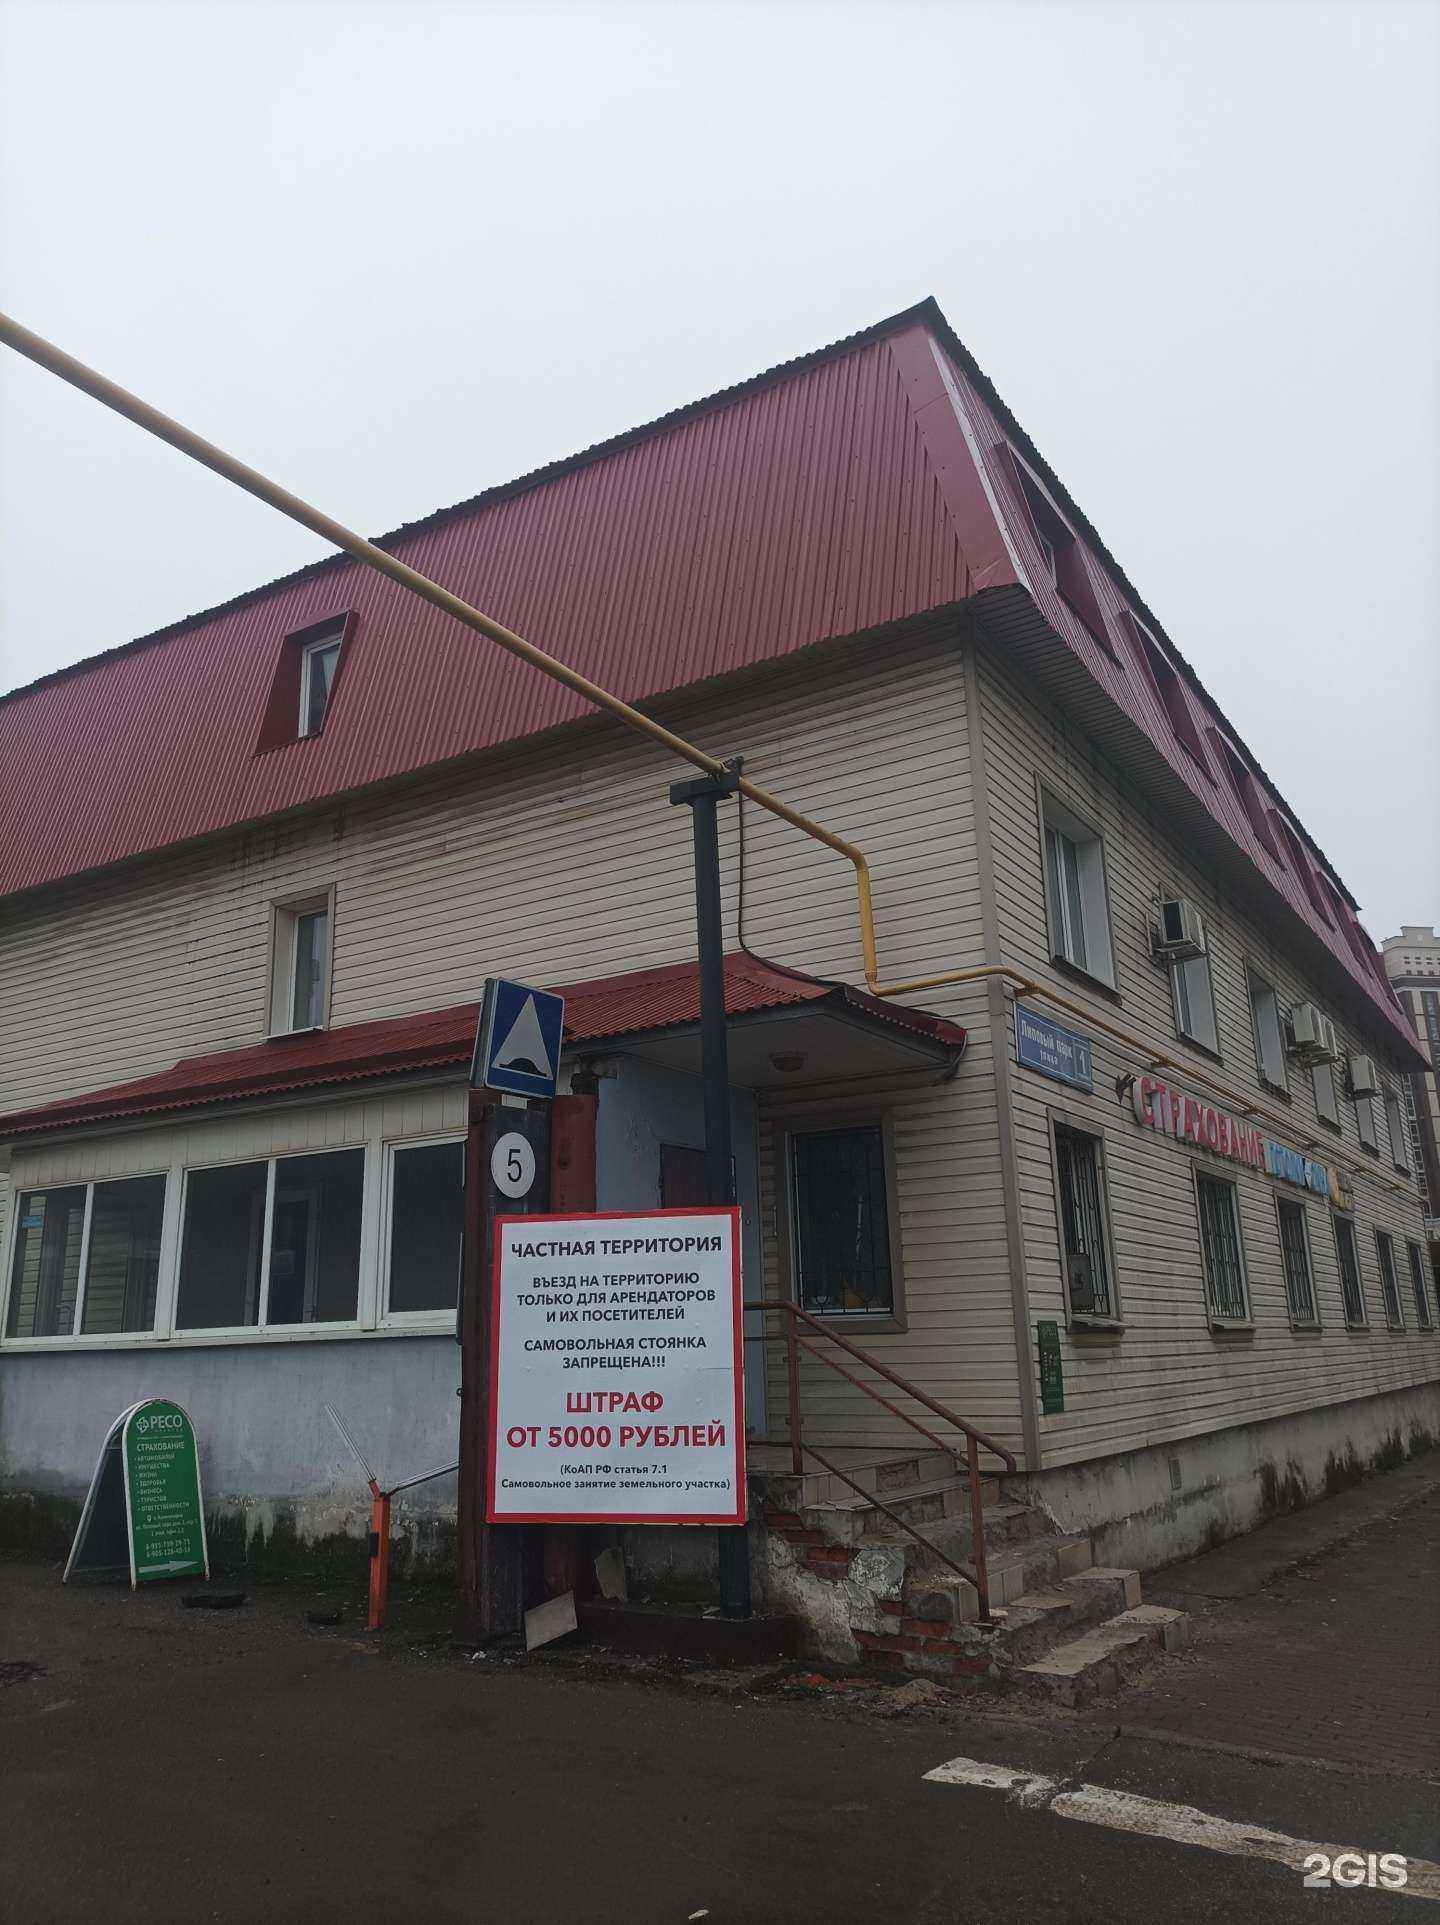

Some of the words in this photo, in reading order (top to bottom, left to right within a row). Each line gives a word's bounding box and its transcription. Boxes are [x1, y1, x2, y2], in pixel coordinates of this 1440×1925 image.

[1080, 1050, 1086, 1074] 1
[1133, 1076, 1265, 1168] СТРАХОВАНИЕ
[507, 1149, 522, 1183] 5
[511, 1241, 595, 1258] ЧАСТНАЯ
[600, 1236, 722, 1255] ТЕРРИТОРИЯ
[533, 1276, 577, 1289] ВЪЕЗД
[580, 1275, 599, 1287] НА
[603, 1272, 700, 1286] ТЕРРИТОРИЮ
[517, 1293, 573, 1305] ТОЛЬКО
[576, 1292, 606, 1306] ДЛЯ
[610, 1289, 716, 1304] АРЕНДАТОРОВ
[546, 1311, 556, 1322] И
[560, 1311, 579, 1322] ИХ
[582, 1306, 685, 1321] ПОСЕТИТЕЛЕЙ
[524, 1337, 634, 1352] САМОВОЛЬНАЯ
[638, 1336, 707, 1349] СТОЯНКА
[562, 1356, 666, 1370] ЗАПРЕЩЕНА!!!
[566, 1390, 664, 1414] ШТРАФ
[150, 1415, 183, 1429] РЕСО
[507, 1426, 542, 1448] ОТ
[548, 1425, 612, 1448] 5000
[619, 1419, 726, 1448] РУБЛЕЙ
[137, 1441, 185, 1452] СТРАХОВАНИЕ
[560, 1465, 593, 1476] (КоАП
[595, 1464, 612, 1475] РФ
[614, 1466, 649, 1475] статья
[651, 1464, 668, 1474] 7.1
[501, 1478, 572, 1489] Самовольное
[574, 1480, 617, 1489] занятие
[619, 1480, 682, 1489] земельного
[685, 1478, 731, 1490] участка)
